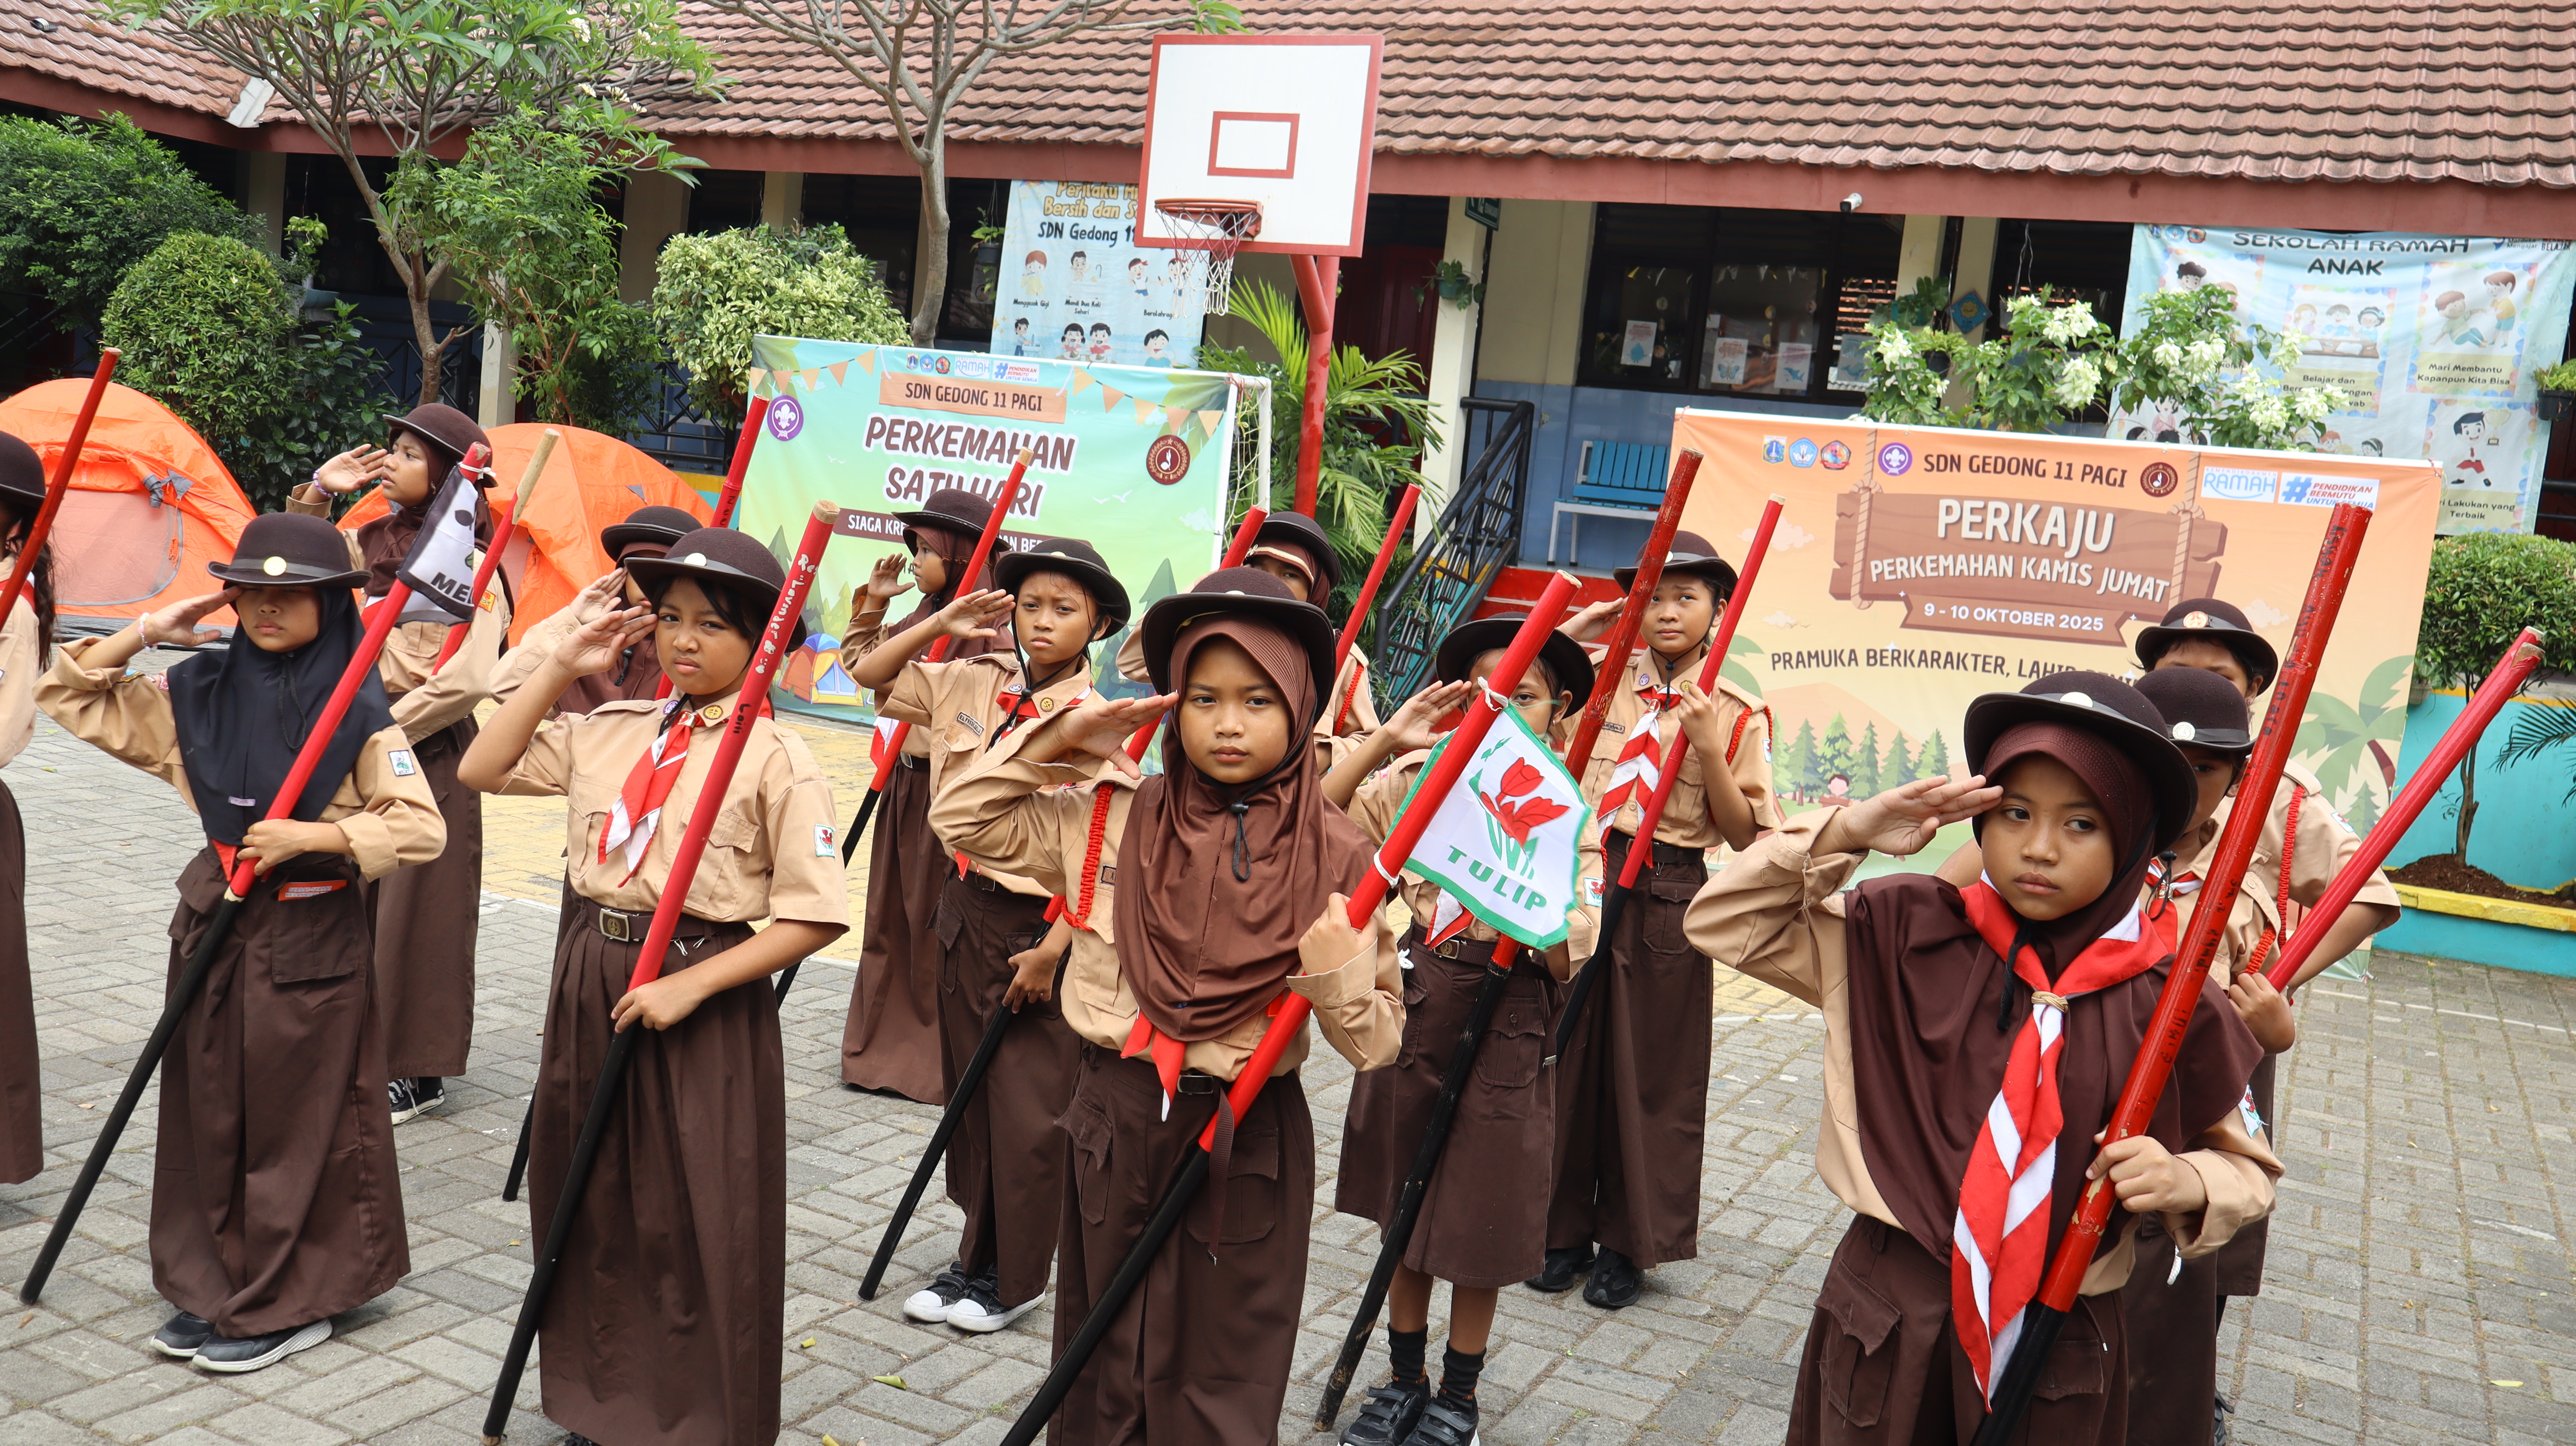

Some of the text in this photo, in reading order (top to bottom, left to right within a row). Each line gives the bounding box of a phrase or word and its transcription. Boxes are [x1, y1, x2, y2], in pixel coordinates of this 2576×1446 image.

[1056, 181, 1119, 199] Perilaku
[1044, 196, 1088, 217] Bersih
[1093, 200, 1120, 219] dan
[1038, 222, 1064, 239] SDN
[1070, 223, 1118, 248] Gedong
[2233, 232, 2470, 253] SEKOLAH RAMAH
[2541, 243, 2571, 251] BELAJAR
[2307, 258, 2384, 276] ANAK
[1039, 300, 1049, 308] Gigi
[1143, 309, 1175, 320] Berolahrag
[955, 360, 990, 374] RAMAH
[2453, 365, 2503, 373] Membantu
[2303, 375, 2335, 383] Belajar
[2417, 375, 2465, 384] Kapanpun
[905, 382, 1042, 411] SDN GEDONG 11 PAGI
[865, 416, 1075, 471] PERKEMAHAN
[1923, 454, 2127, 488] SDN GEDONG 11 PAGI
[2206, 468, 2277, 476] KEMENDIKDASMEN
[2203, 472, 2276, 493] RAMAH
[2313, 483, 2373, 493] PENDIDIKAN
[2306, 497, 2337, 506] UNTUK
[2310, 490, 2356, 499] BERMUTU
[2448, 500, 2488, 509] Lakukan
[2491, 504, 2515, 512] yang
[2450, 510, 2486, 519] Terbaik
[848, 514, 882, 533] SIAGA
[1937, 498, 2115, 558] PERKAJU
[1869, 553, 2170, 603] PERKEMAHAN KAMIS JUMAT
[1923, 602, 1935, 617] 9
[1950, 605, 1970, 620] 10
[1974, 607, 2055, 628] OKTOBER
[2059, 614, 2104, 632] 2025
[1771, 649, 1859, 671] PRAMUKA
[1866, 648, 2010, 678] BERKARAKTER,
[1446, 845, 1547, 911] TULIP
